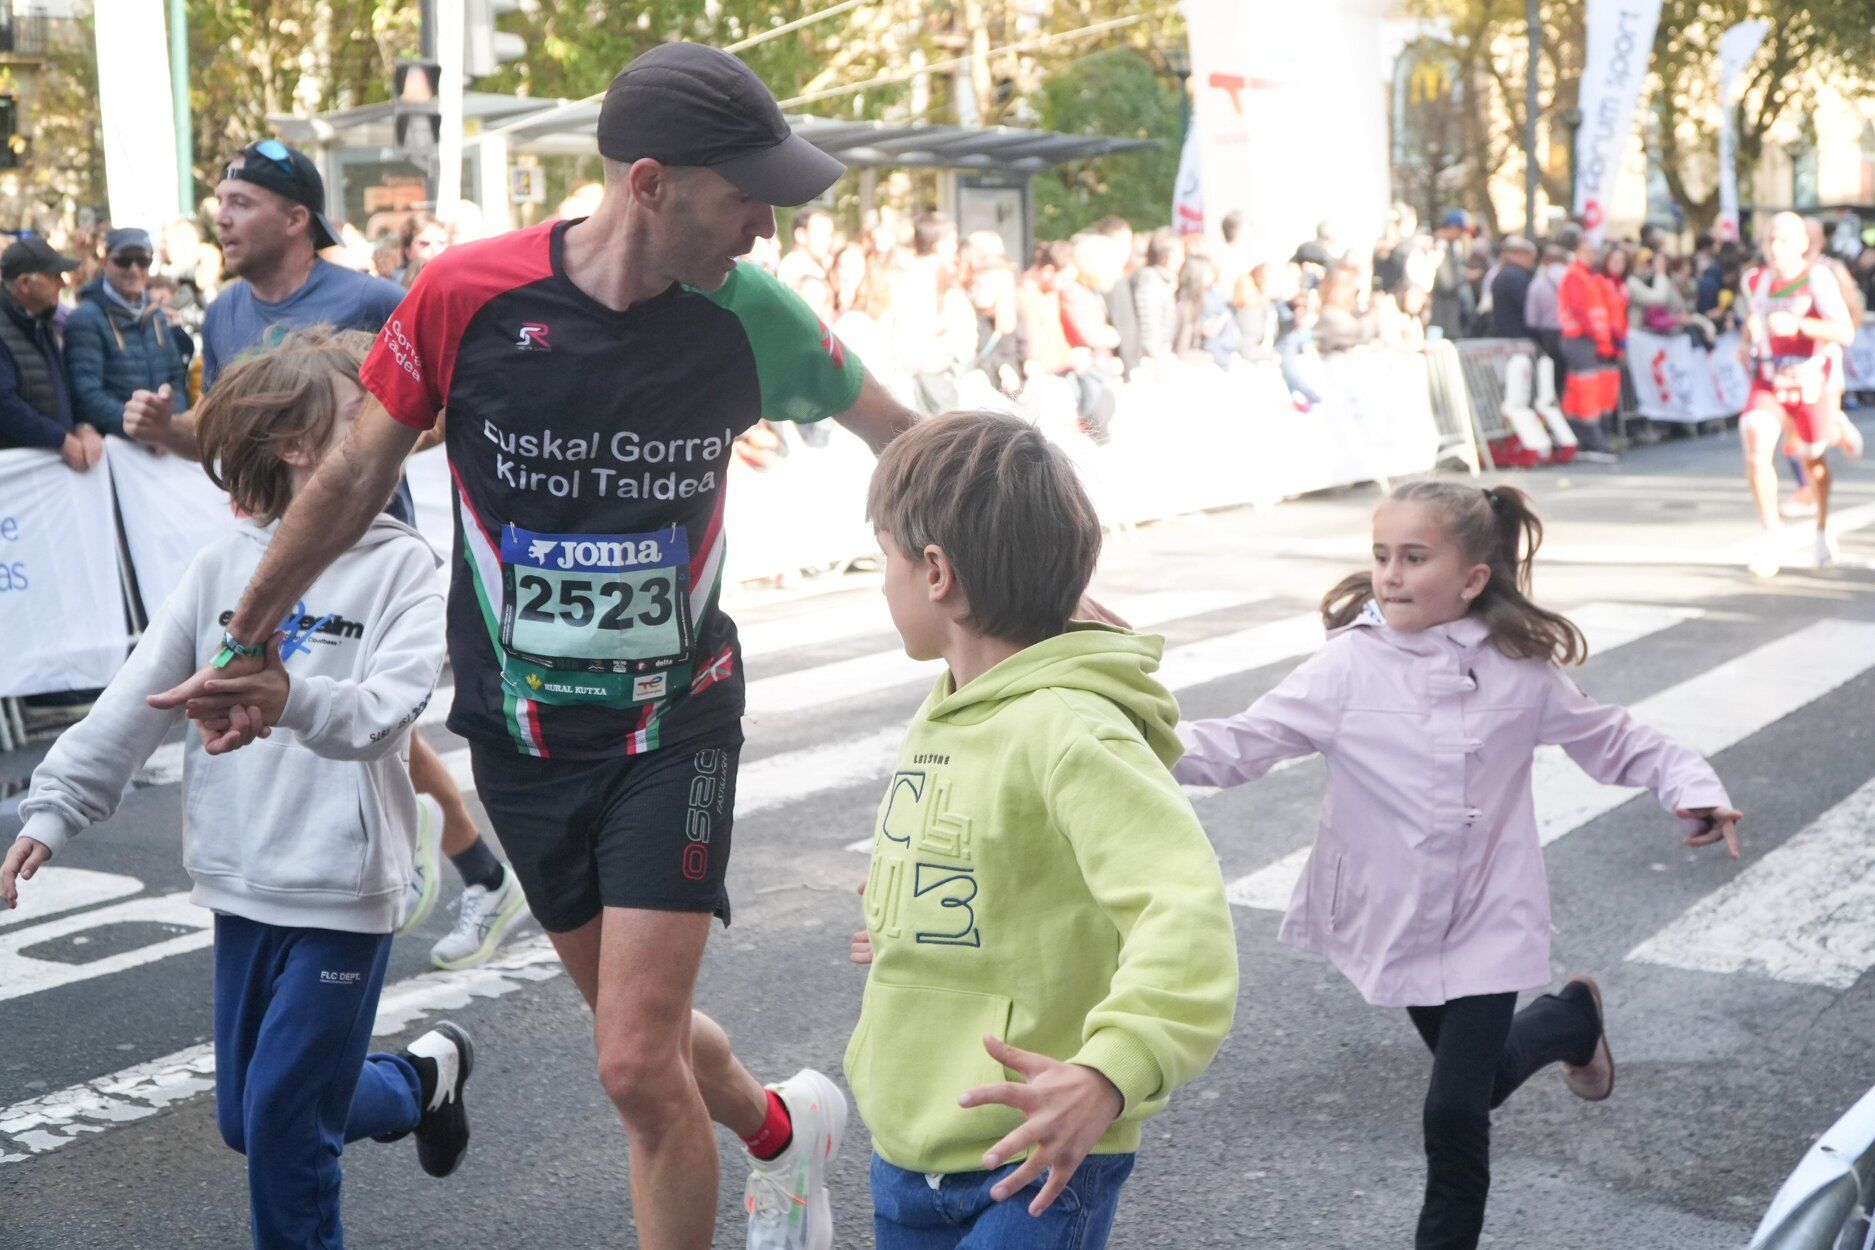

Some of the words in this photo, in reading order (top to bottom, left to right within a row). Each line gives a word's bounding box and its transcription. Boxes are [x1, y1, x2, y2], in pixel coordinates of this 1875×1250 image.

[496, 453, 580, 499] Kirol
[590, 467, 716, 501] Taldea
[518, 574, 673, 631] 2523
[544, 683, 574, 694] RURAL
[574, 686, 608, 697] KUTXA
